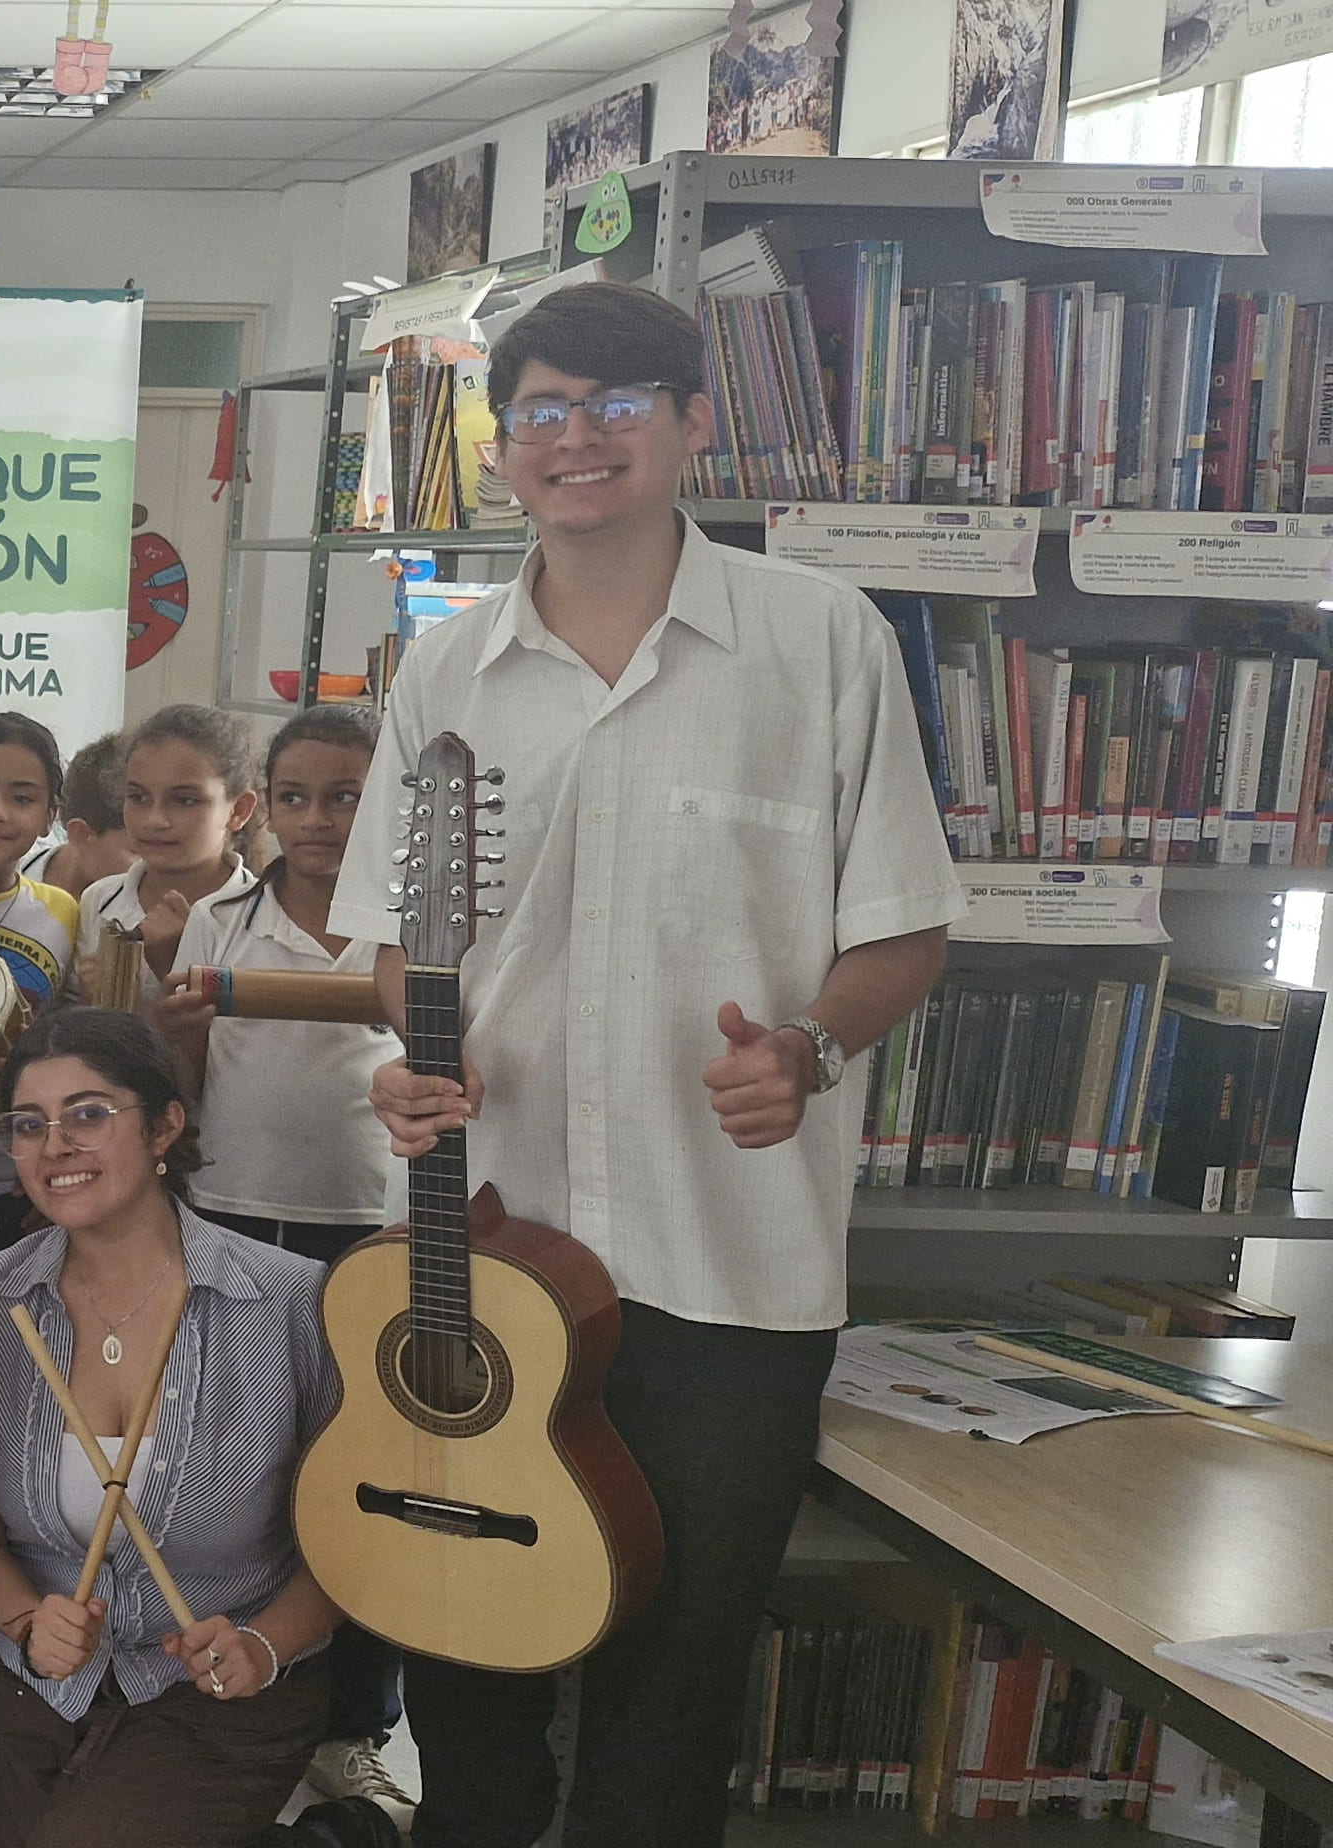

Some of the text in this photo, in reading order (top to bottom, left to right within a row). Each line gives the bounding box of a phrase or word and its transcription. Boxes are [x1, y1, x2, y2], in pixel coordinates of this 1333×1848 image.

[1087, 197, 1118, 206] Obras
[935, 365, 949, 437] Informática
[826, 528, 844, 537] 100
[895, 530, 947, 541] psicología
[949, 533, 955, 541] y
[957, 530, 981, 540] ética
[1178, 538, 1241, 549] 200 Religión
[990, 888, 1033, 896] Ciencias
[1035, 888, 1077, 896] sociales
